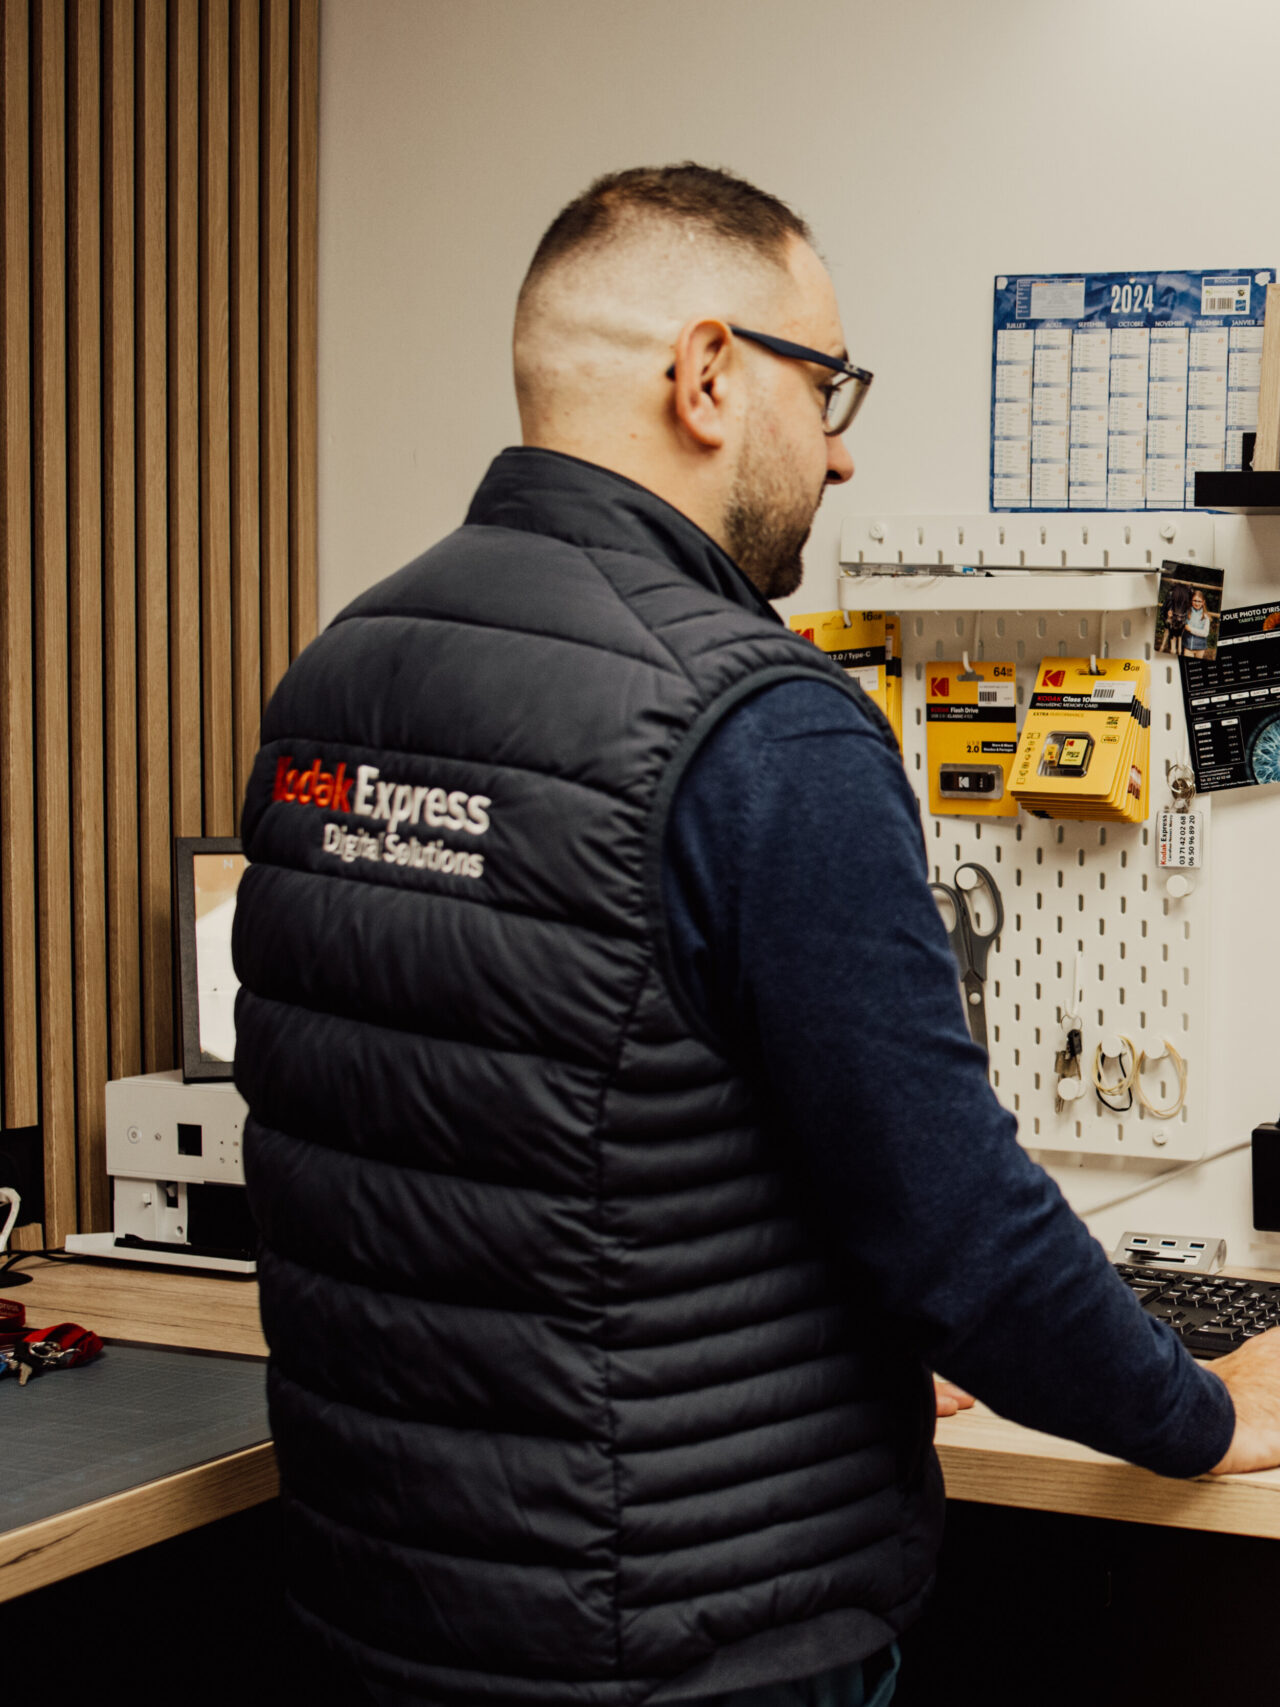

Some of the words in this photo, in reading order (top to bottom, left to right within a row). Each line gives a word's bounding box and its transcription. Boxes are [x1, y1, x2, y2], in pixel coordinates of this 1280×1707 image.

[1111, 284, 1154, 313] 2024
[1232, 319, 1255, 327] JANVIER
[1223, 612, 1239, 621] JOLIE
[1240, 608, 1261, 618] PHOTO
[1262, 605, 1280, 614] D'IRIS
[993, 666, 1006, 677] 64
[966, 745, 980, 753] 2.0
[272, 756, 354, 814] Kodak
[354, 765, 492, 835] Express
[1180, 816, 1186, 825] 68
[1190, 815, 1195, 824] 20
[1180, 826, 1186, 835] 02
[1189, 826, 1195, 835] 89
[1180, 837, 1186, 845] 42
[1189, 836, 1195, 845] 96
[323, 823, 383, 863] Digital
[384, 831, 485, 879] Solutions
[1188, 846, 1195, 855] 50
[1179, 856, 1185, 865] 03
[1188, 857, 1194, 866] 06
